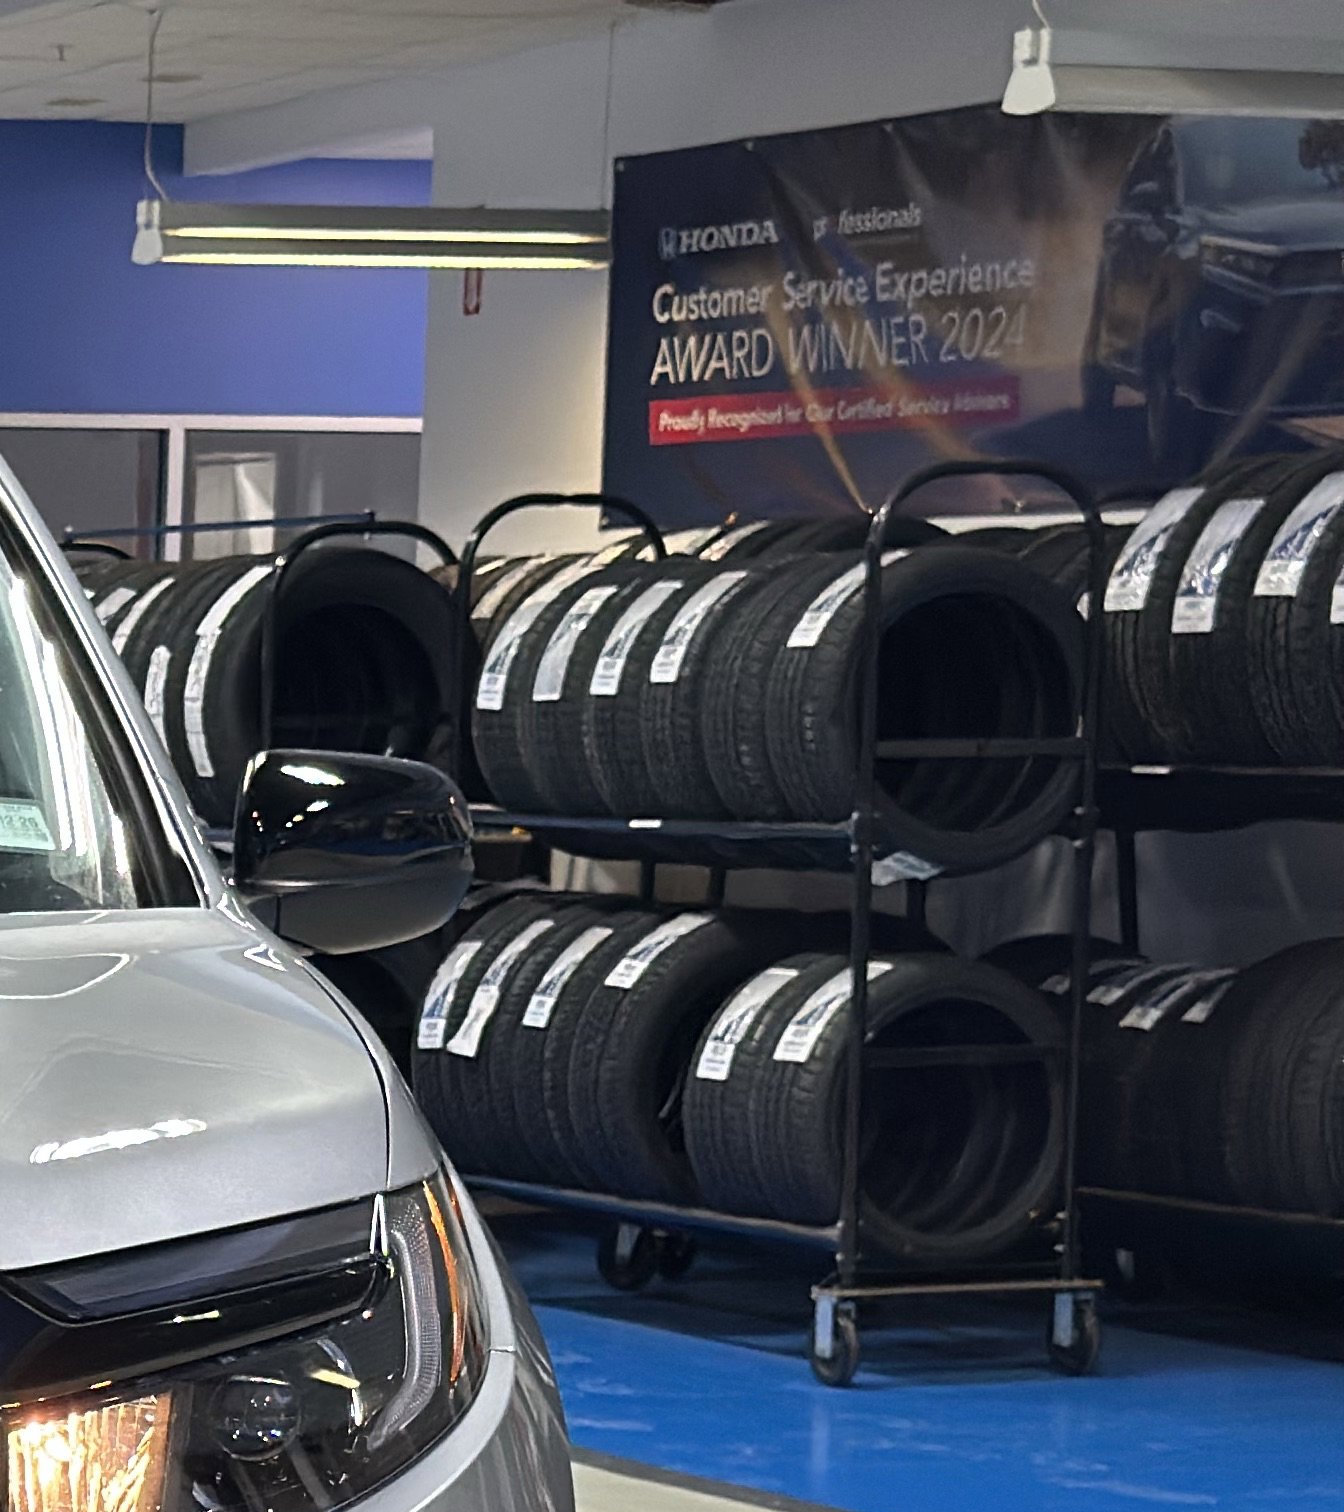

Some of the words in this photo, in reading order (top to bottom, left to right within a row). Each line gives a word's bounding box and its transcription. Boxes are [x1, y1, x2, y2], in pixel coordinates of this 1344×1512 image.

[679, 219, 779, 254] HONDA
[652, 283, 772, 323] Customer
[782, 267, 870, 311] Service
[876, 254, 1034, 309] Experience
[650, 327, 774, 386] AWARD
[787, 315, 928, 373] WINNER
[939, 304, 1026, 363] 2024
